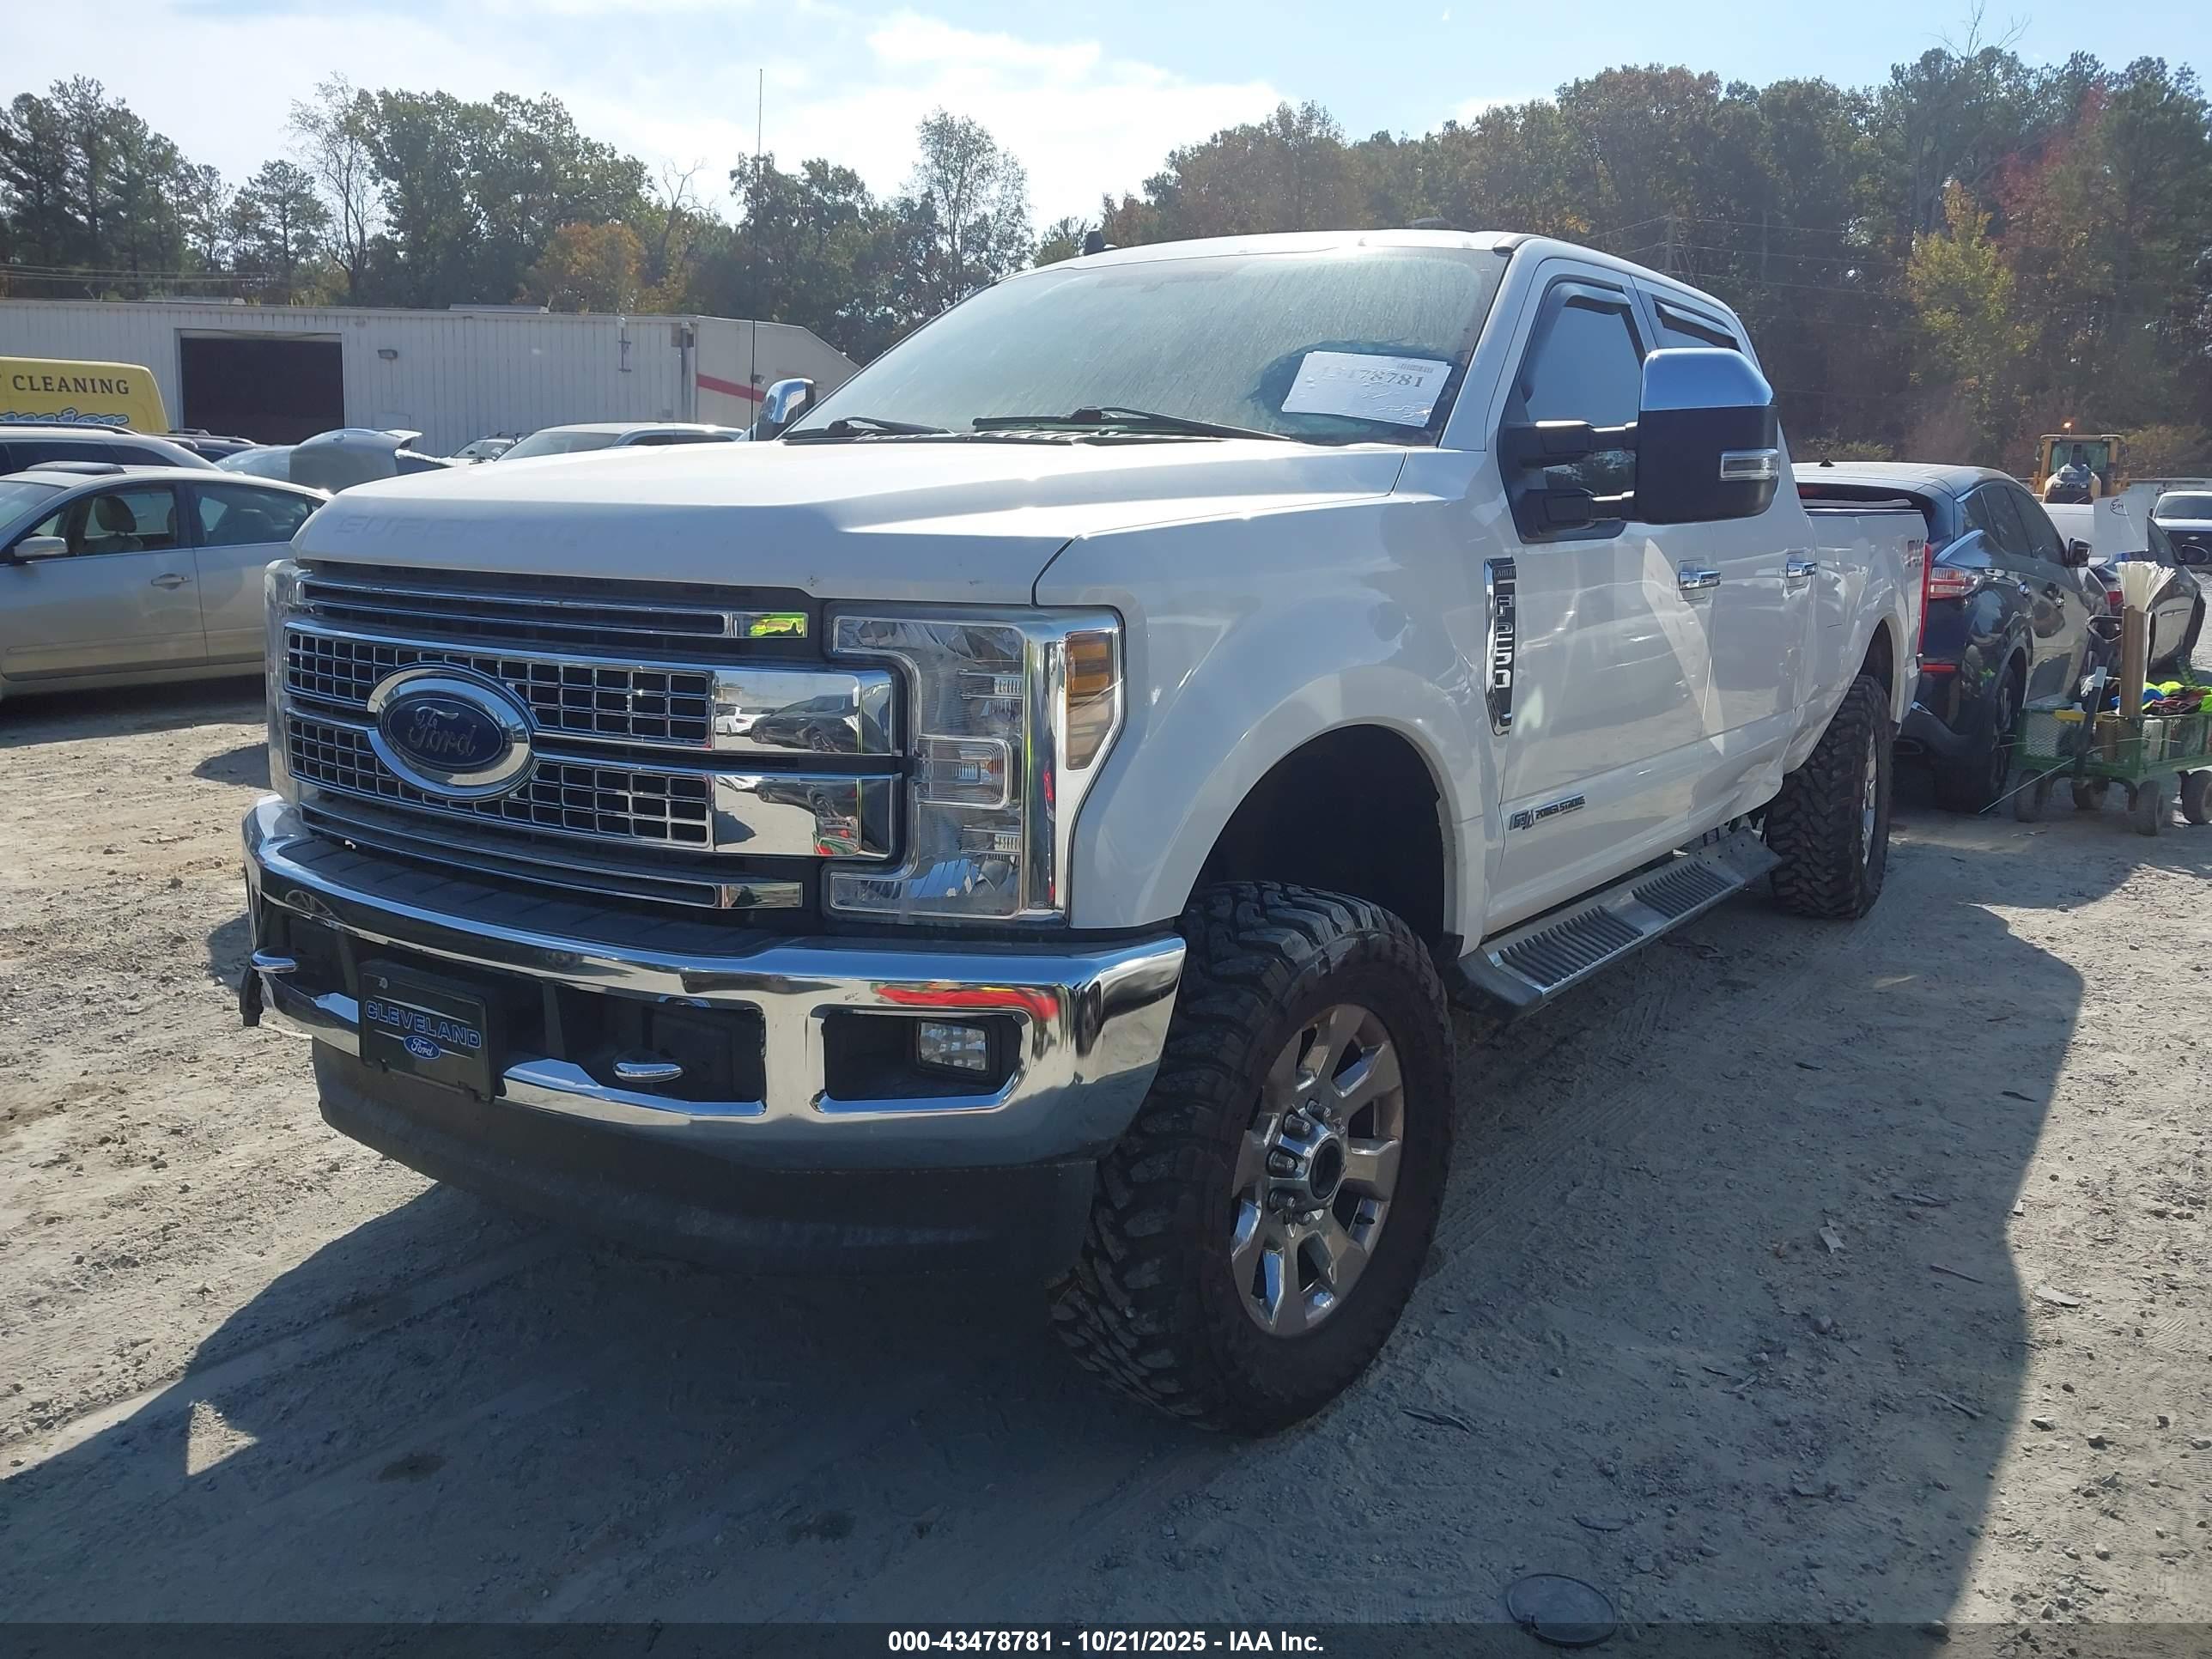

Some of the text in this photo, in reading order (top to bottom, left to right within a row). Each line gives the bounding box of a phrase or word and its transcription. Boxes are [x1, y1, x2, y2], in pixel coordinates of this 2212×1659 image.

[12, 374, 131, 395] CLEANING
[1320, 364, 1425, 388] 78781
[408, 706, 477, 757] Ford
[365, 1000, 482, 1048] CLEVELAND
[410, 1037, 434, 1057] Ford
